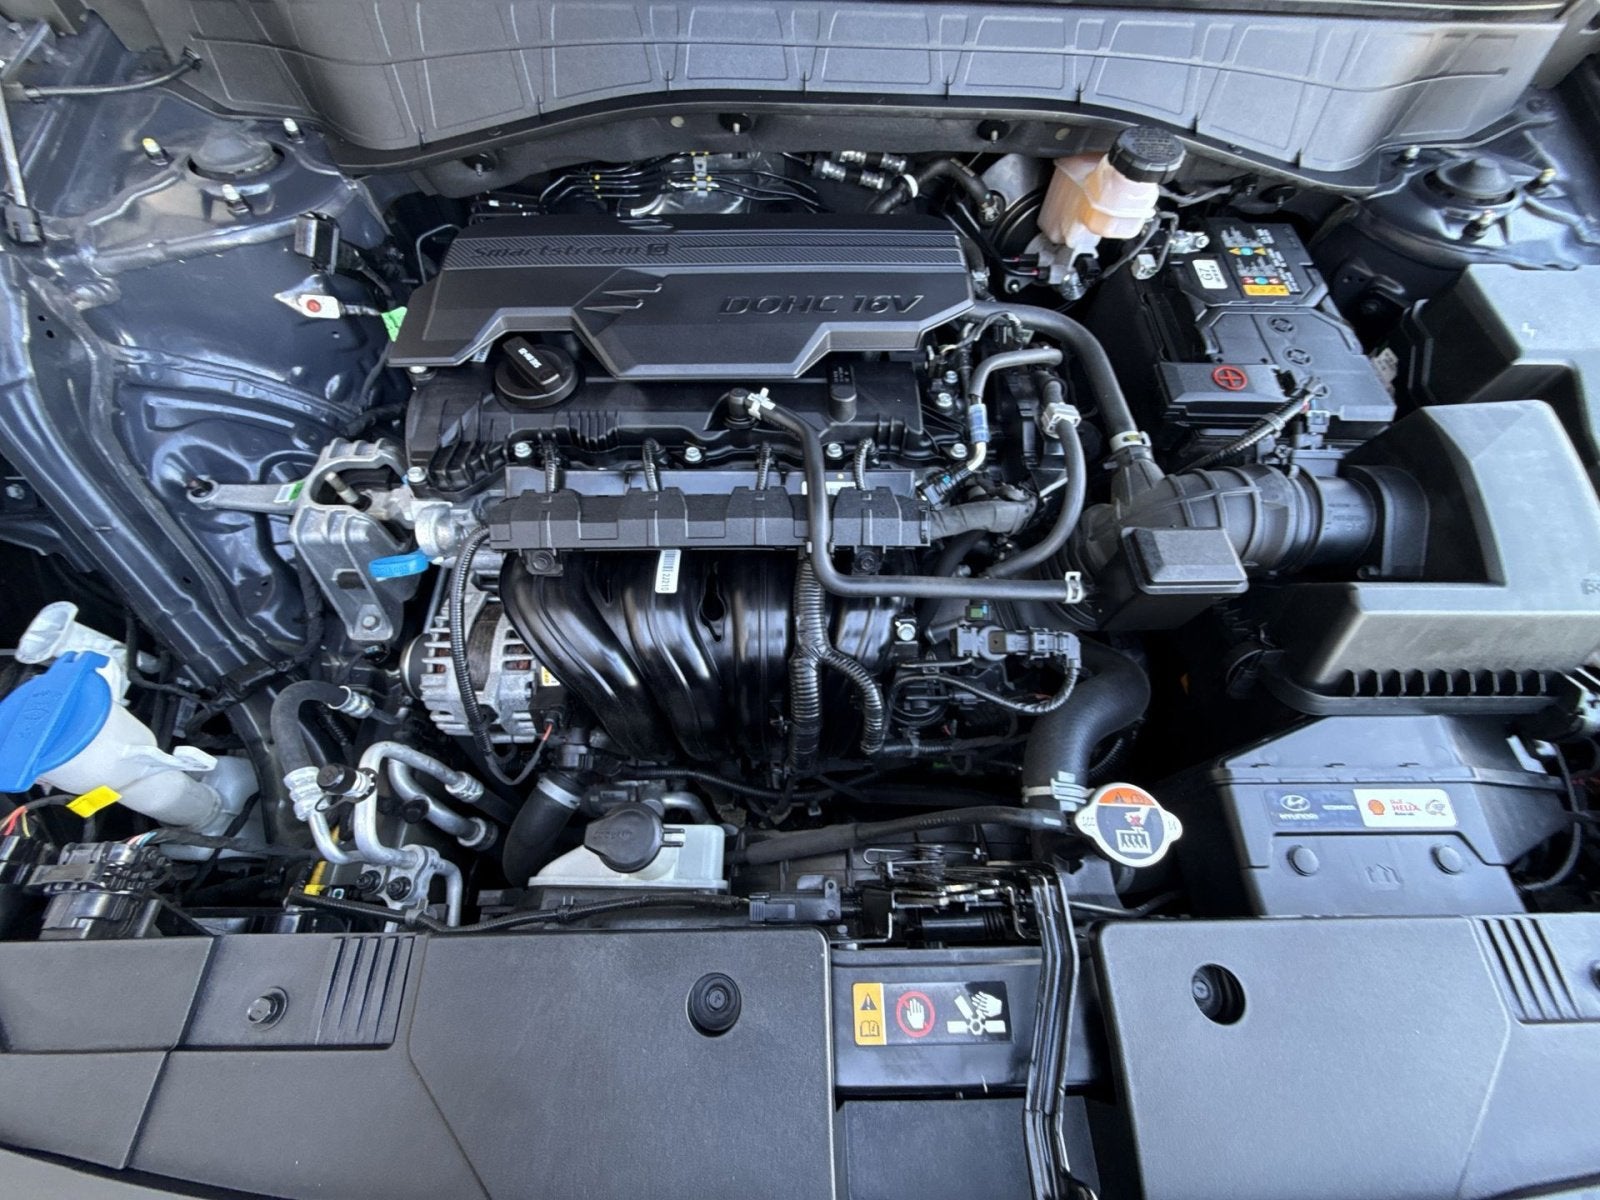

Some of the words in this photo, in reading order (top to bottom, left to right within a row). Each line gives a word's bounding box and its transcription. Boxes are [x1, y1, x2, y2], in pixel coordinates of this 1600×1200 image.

[473, 245, 642, 258] Smartstream
[718, 295, 845, 315] DOHC
[852, 295, 924, 314] 16V
